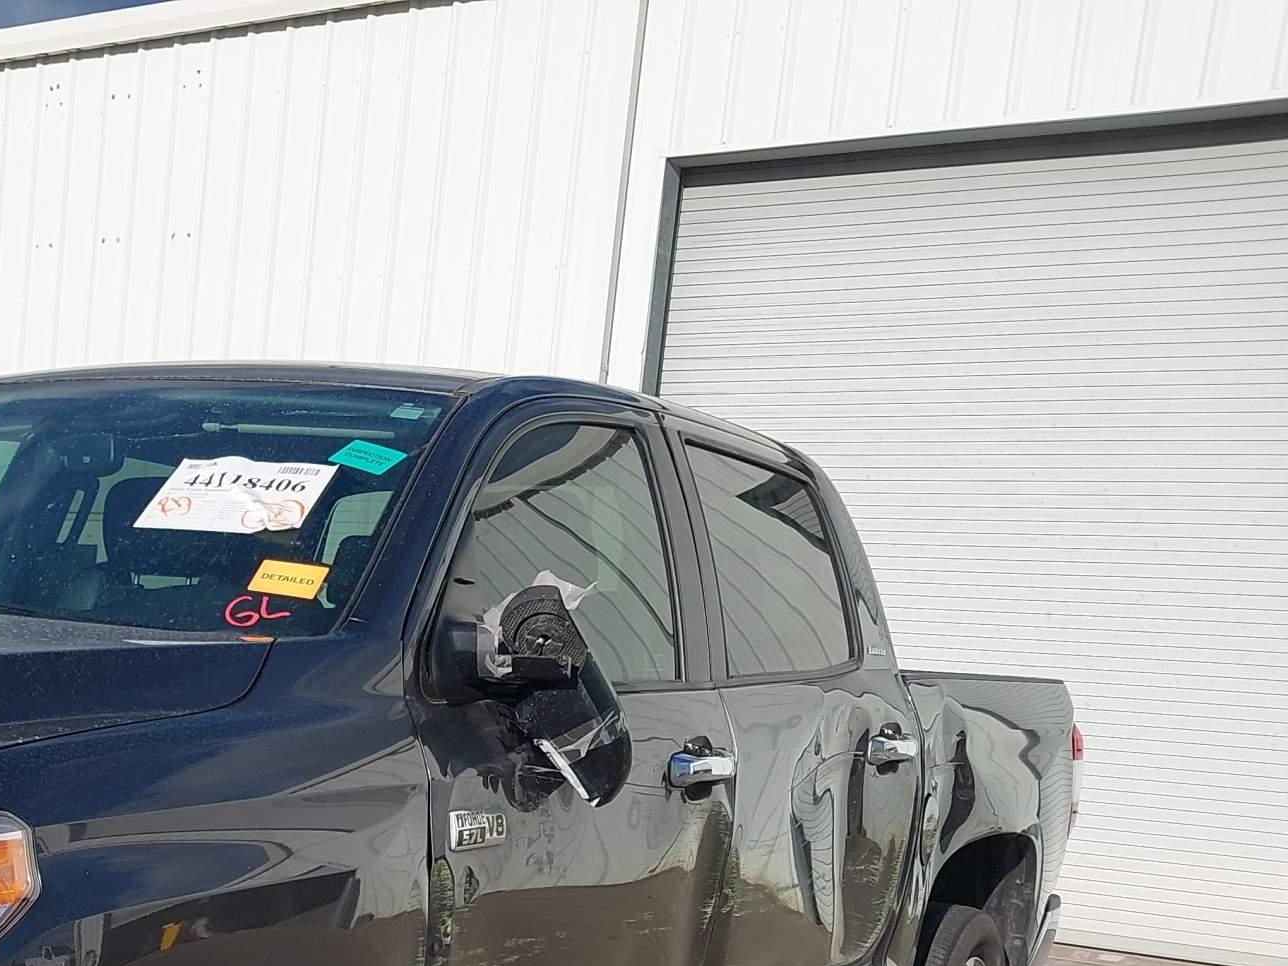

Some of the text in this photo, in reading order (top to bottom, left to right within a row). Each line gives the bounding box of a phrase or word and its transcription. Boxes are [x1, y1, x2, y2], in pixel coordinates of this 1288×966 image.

[184, 471, 310, 493] 44118406
[261, 572, 315, 586] DETAILED
[224, 595, 291, 627] GL
[486, 814, 504, 837] V8
